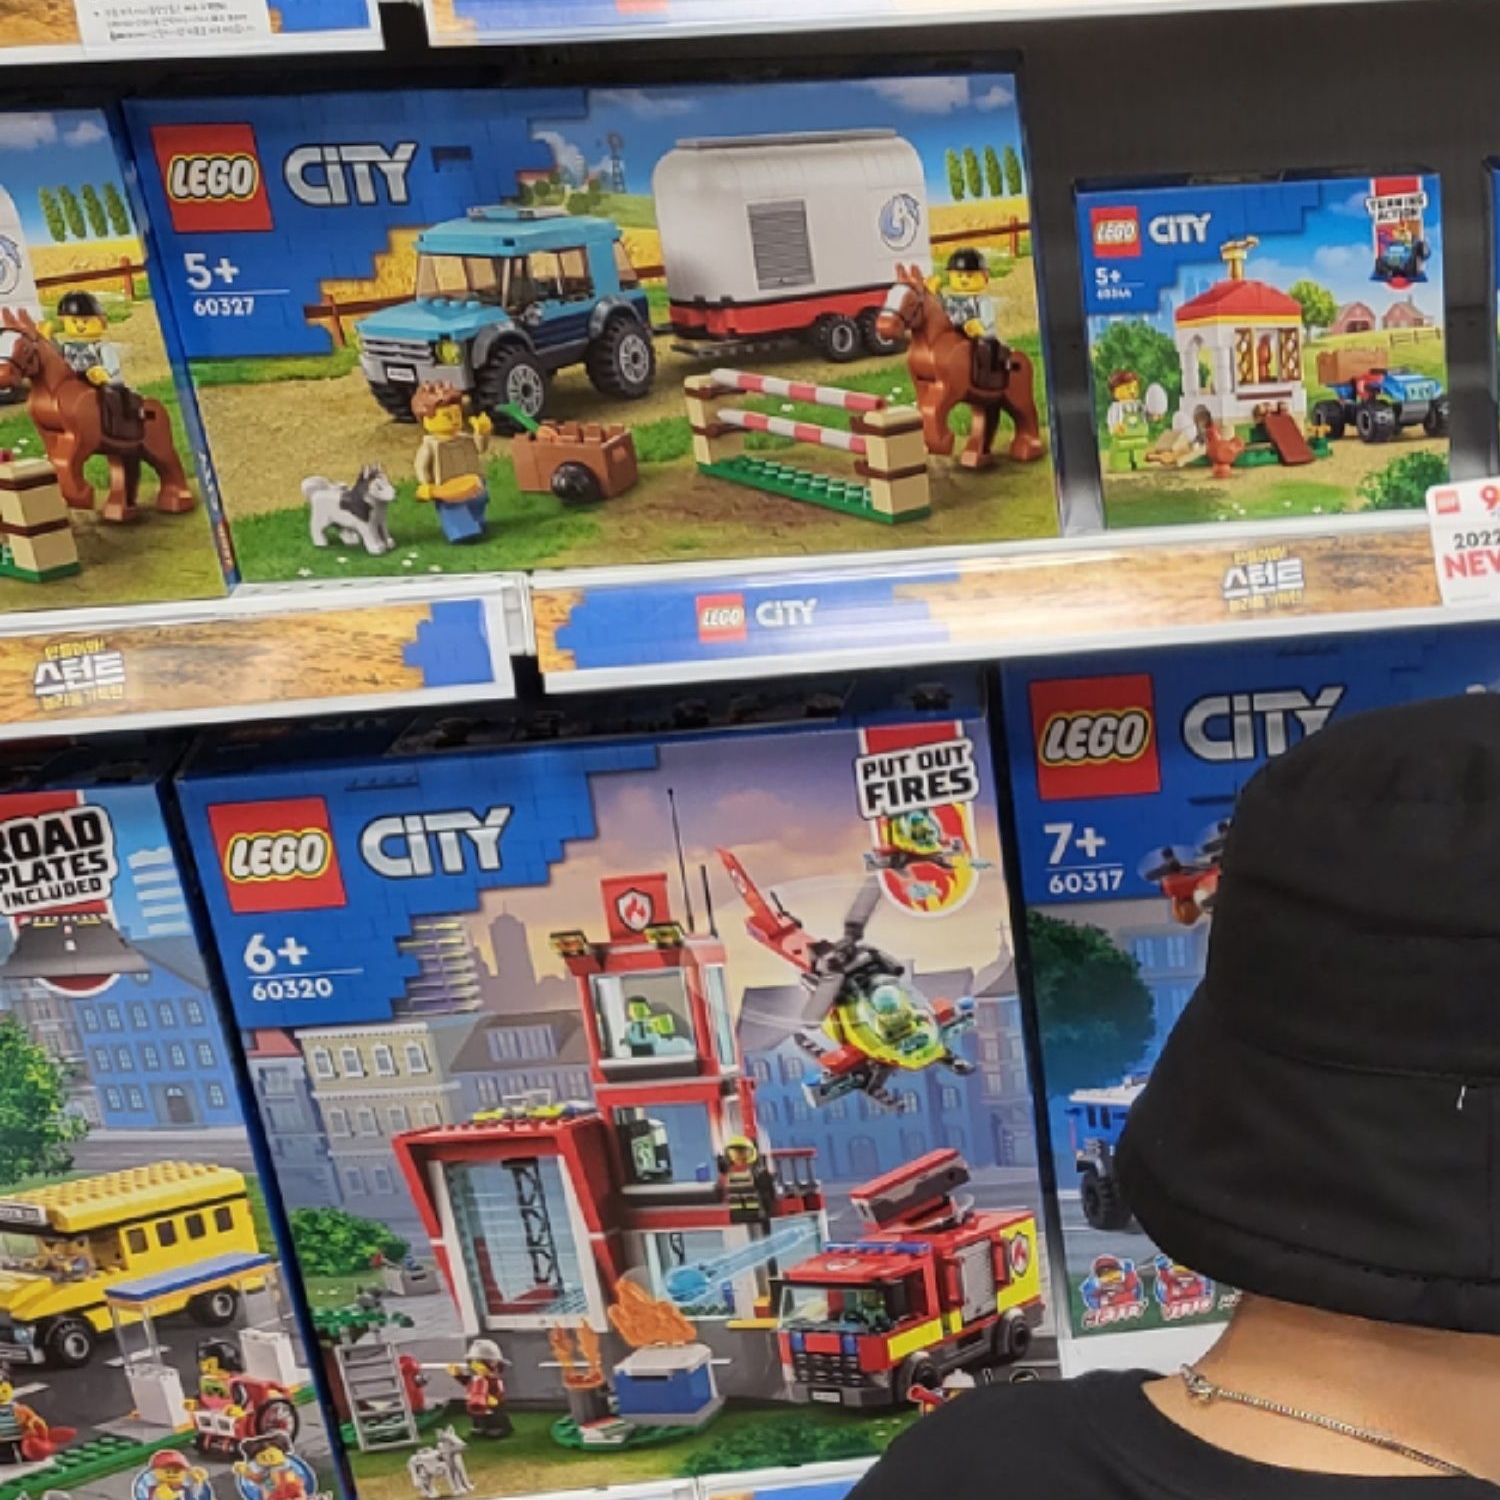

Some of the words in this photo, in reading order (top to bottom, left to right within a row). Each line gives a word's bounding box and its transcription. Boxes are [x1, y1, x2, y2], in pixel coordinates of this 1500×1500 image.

[167, 153, 258, 202] LEGO
[284, 142, 418, 206] CITY
[1094, 219, 1138, 246] LEGO
[1148, 212, 1212, 245] CITY
[185, 252, 241, 290] 5+
[1095, 267, 1121, 287] 5+
[193, 295, 256, 318] 60327
[701, 606, 745, 628] LEGO
[754, 598, 819, 629] CITY
[34, 650, 126, 697] 스턴트
[1039, 707, 1151, 767] LEGO
[1182, 685, 1347, 761] CITY
[863, 754, 910, 780] PUT
[918, 746, 966, 771] OUT
[865, 767, 972, 811] FIRES
[224, 827, 332, 884] LEGO
[360, 806, 514, 879] CITY
[1044, 821, 1106, 865] 7+
[4, 877, 103, 908] INCLUDED
[1049, 869, 1123, 895] 60317
[243, 933, 309, 974] 6+
[252, 977, 334, 1001] 60320
